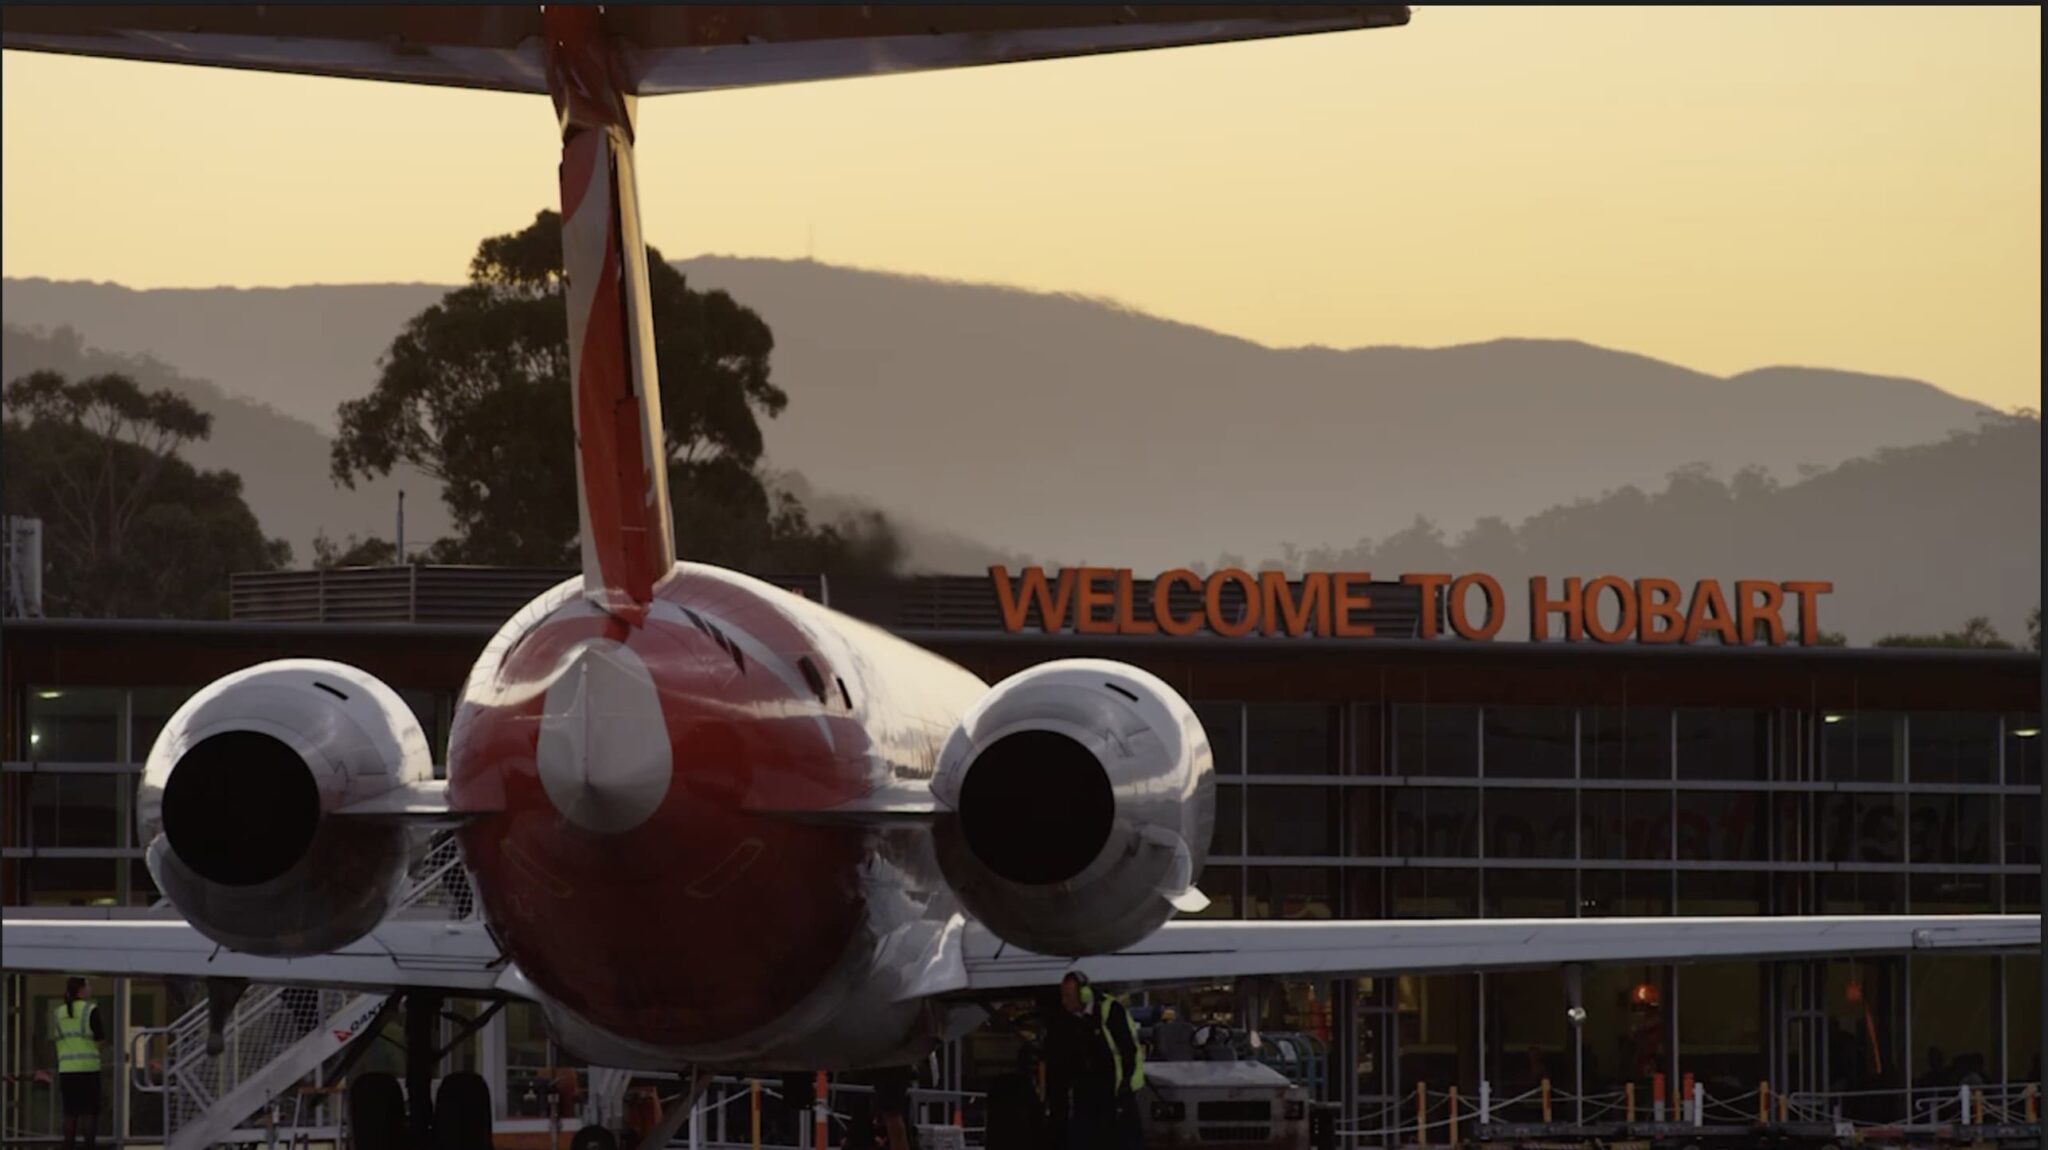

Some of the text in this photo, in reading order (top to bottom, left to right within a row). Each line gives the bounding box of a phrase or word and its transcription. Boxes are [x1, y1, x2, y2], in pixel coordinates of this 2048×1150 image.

[990, 564, 1833, 645] WELCOME TO HOBART
